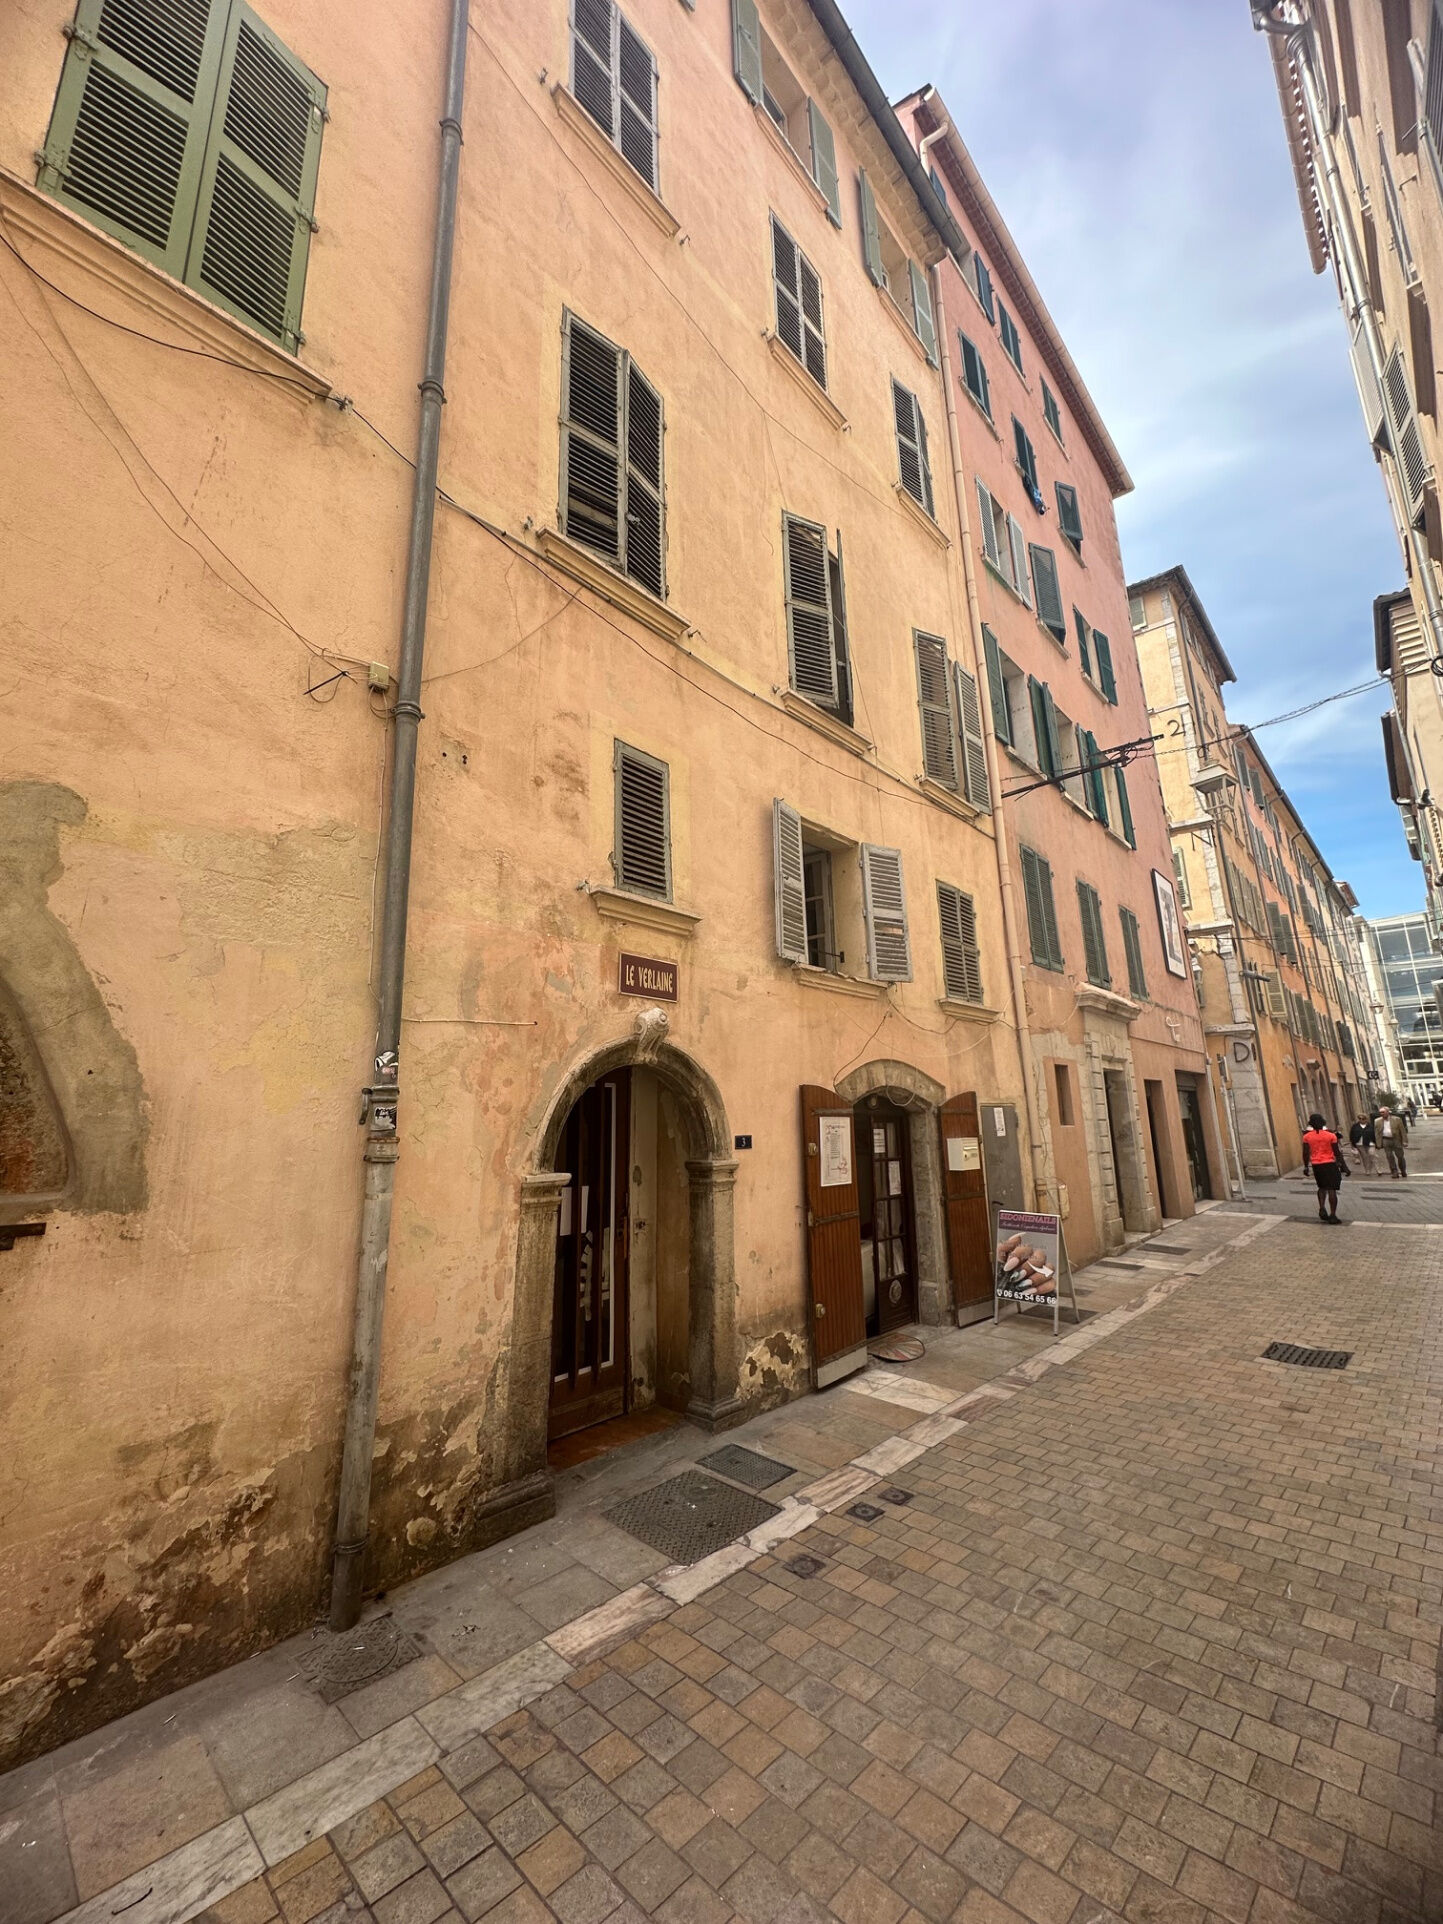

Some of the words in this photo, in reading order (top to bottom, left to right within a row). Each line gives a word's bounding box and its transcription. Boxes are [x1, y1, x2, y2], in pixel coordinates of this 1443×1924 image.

[626, 964, 635, 987] LE
[638, 966, 673, 993] VERLAINE
[1003, 1290, 1013, 1298] 06
[1014, 1291, 1023, 1300] 63
